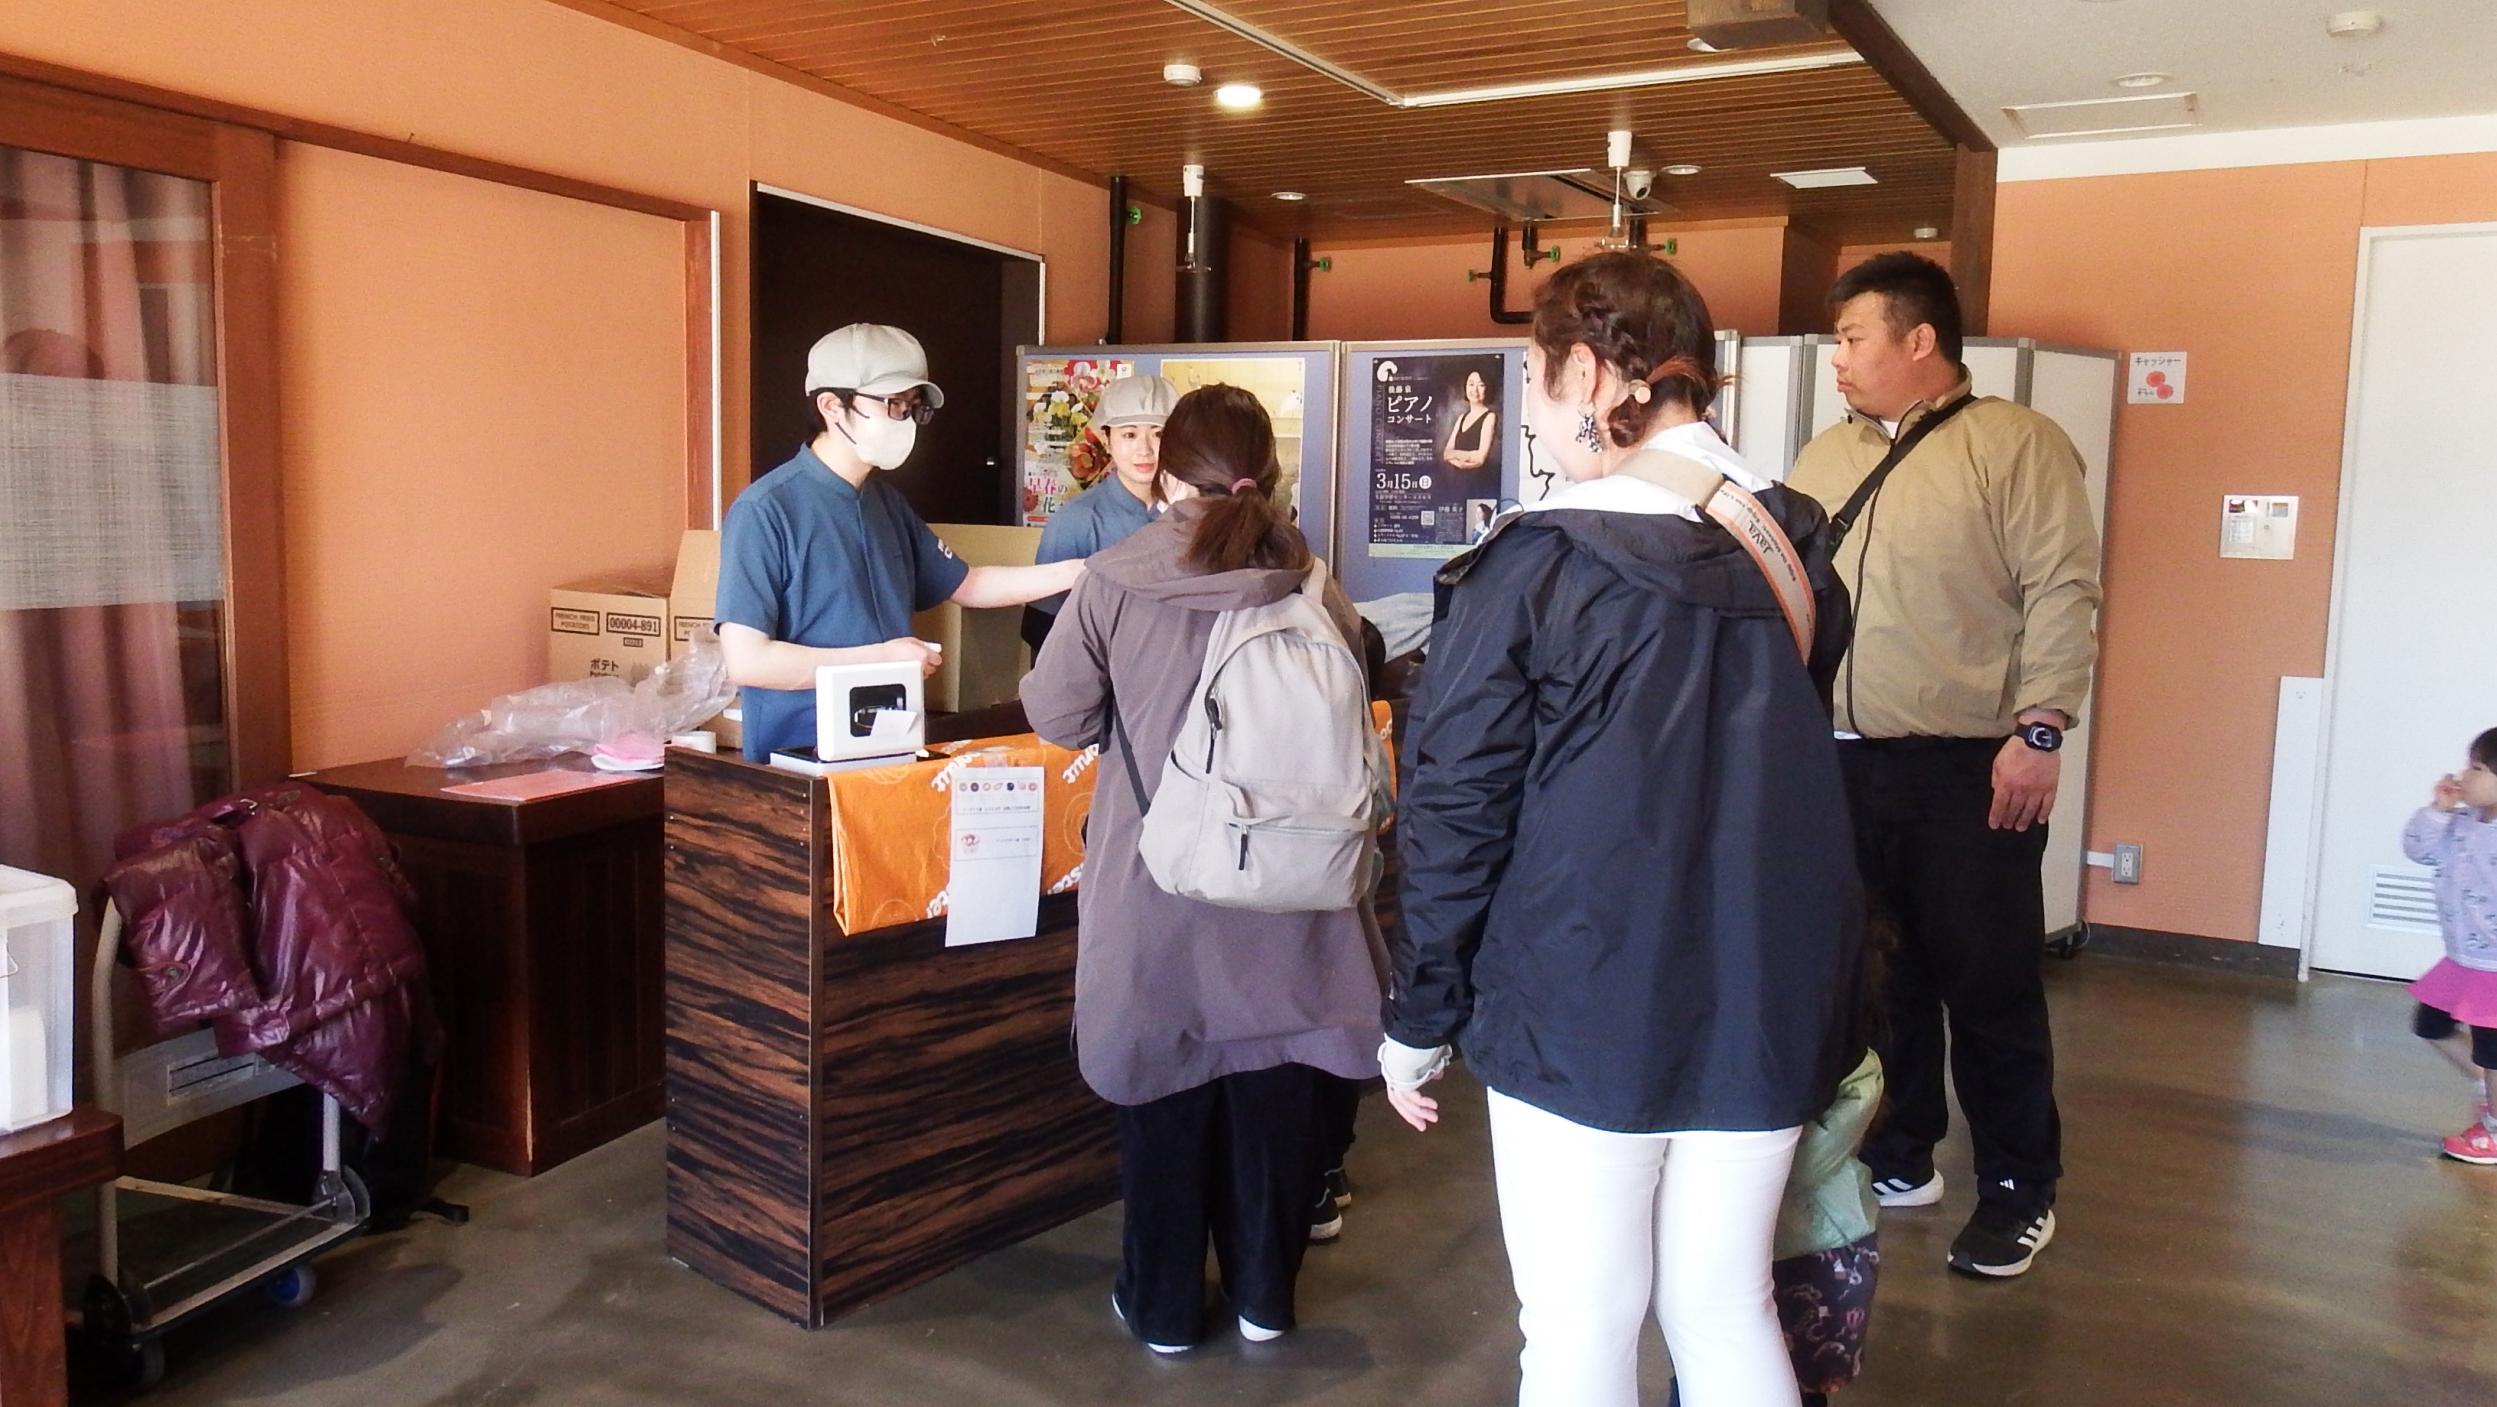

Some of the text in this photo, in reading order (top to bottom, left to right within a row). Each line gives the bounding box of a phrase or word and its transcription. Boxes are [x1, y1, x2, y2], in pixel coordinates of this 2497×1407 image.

[1387, 395, 1433, 413] ピアノ
[1387, 413, 1432, 424] コンサート
[1376, 473, 1418, 489] 3月15日
[609, 617, 658, 633] 00004-891
[590, 658, 619, 672] ポテト
